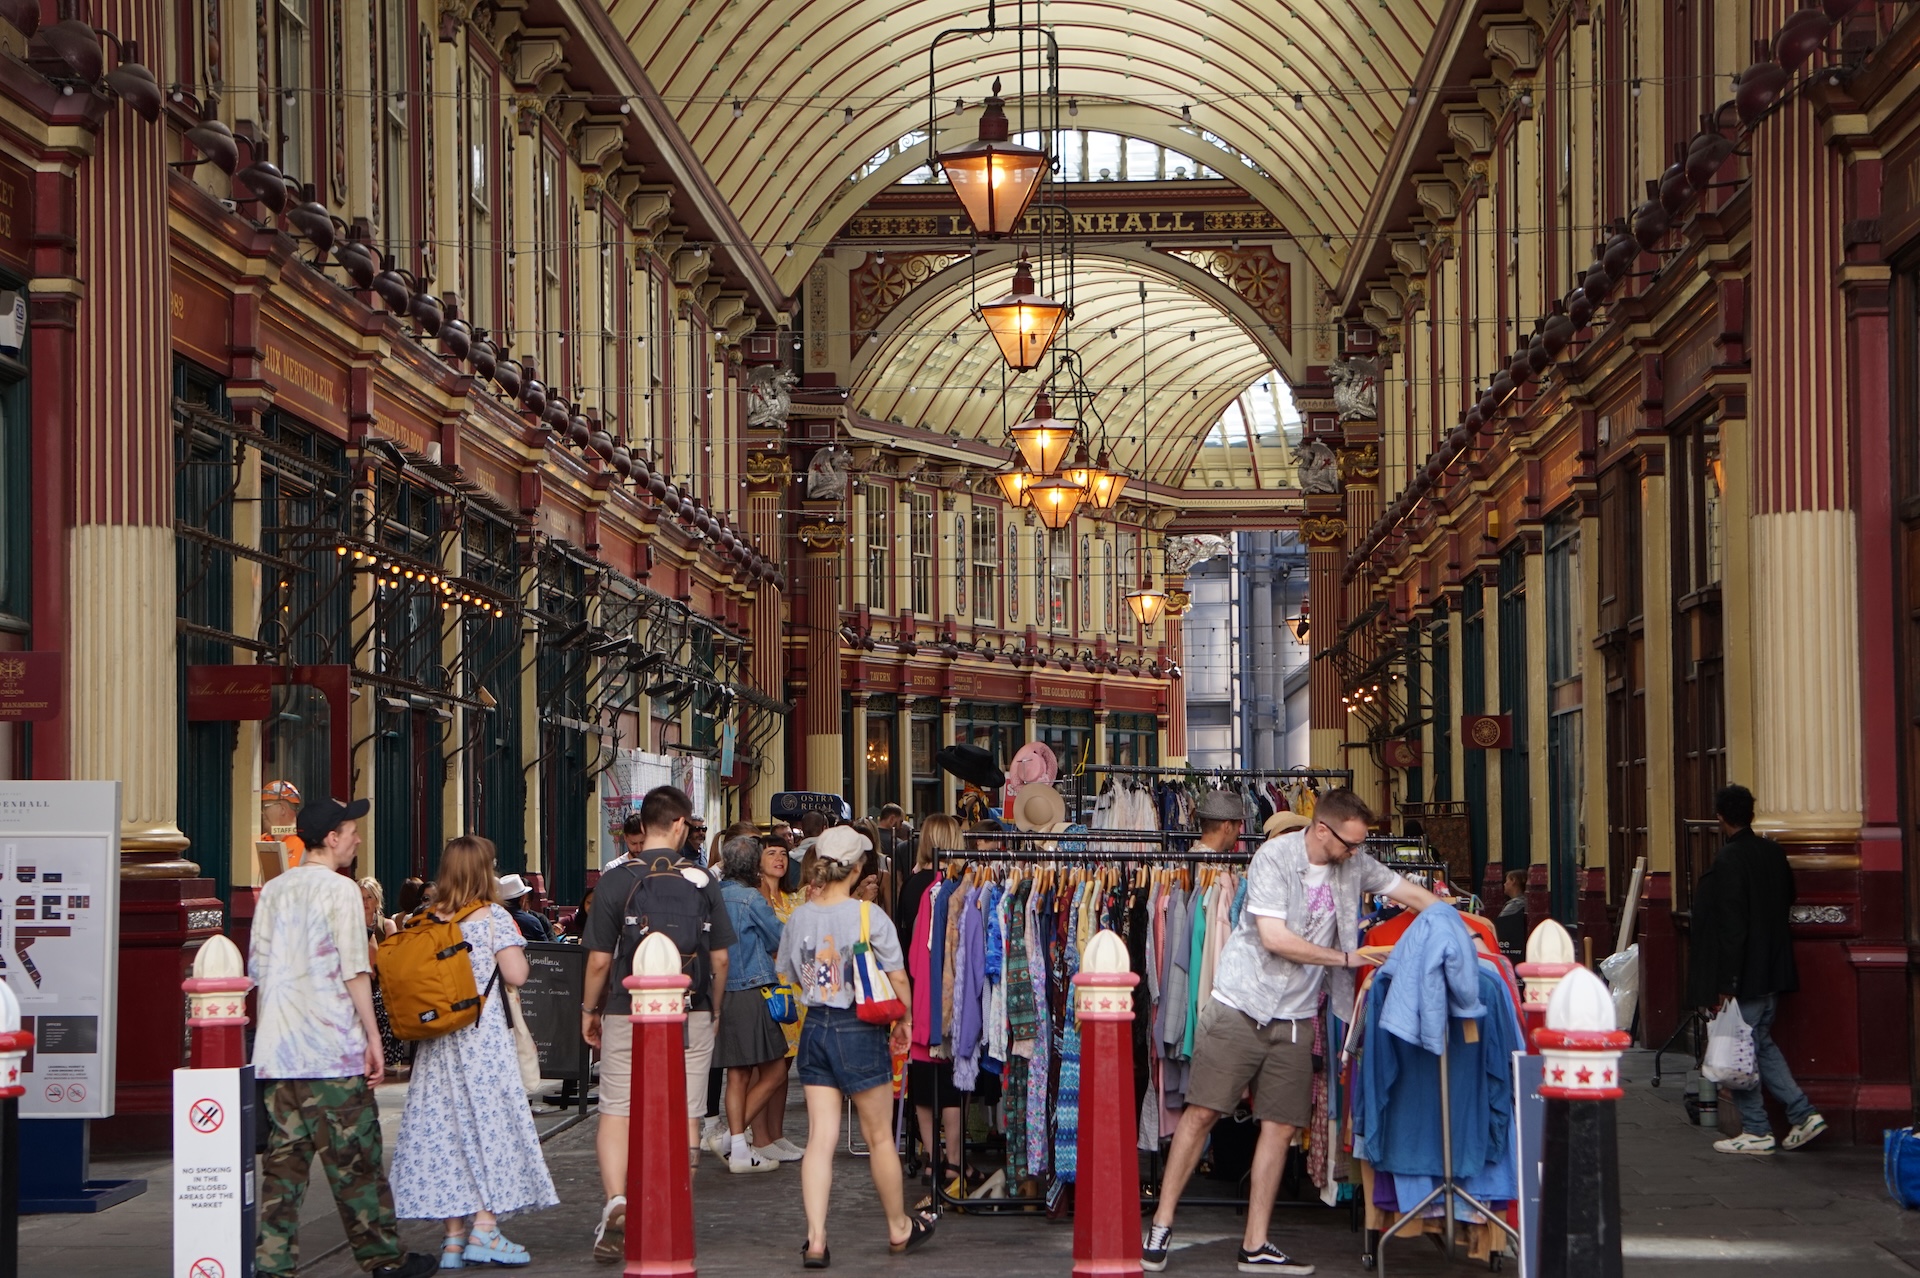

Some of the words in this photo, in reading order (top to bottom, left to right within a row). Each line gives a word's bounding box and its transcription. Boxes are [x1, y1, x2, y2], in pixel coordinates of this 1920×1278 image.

[949, 212, 1194, 235] LDENHALL
[264, 344, 281, 376] AUX
[283, 354, 334, 406] MERVEILLEUX
[870, 671, 891, 682] TAVERN
[1041, 686, 1051, 696] THE
[1051, 687, 1070, 698] GOLDEN
[1070, 689, 1087, 699] GOOSE
[800, 794, 834, 803] OSTRA
[800, 803, 833, 811] REGAL
[191, 1201, 223, 1209] MARKET
